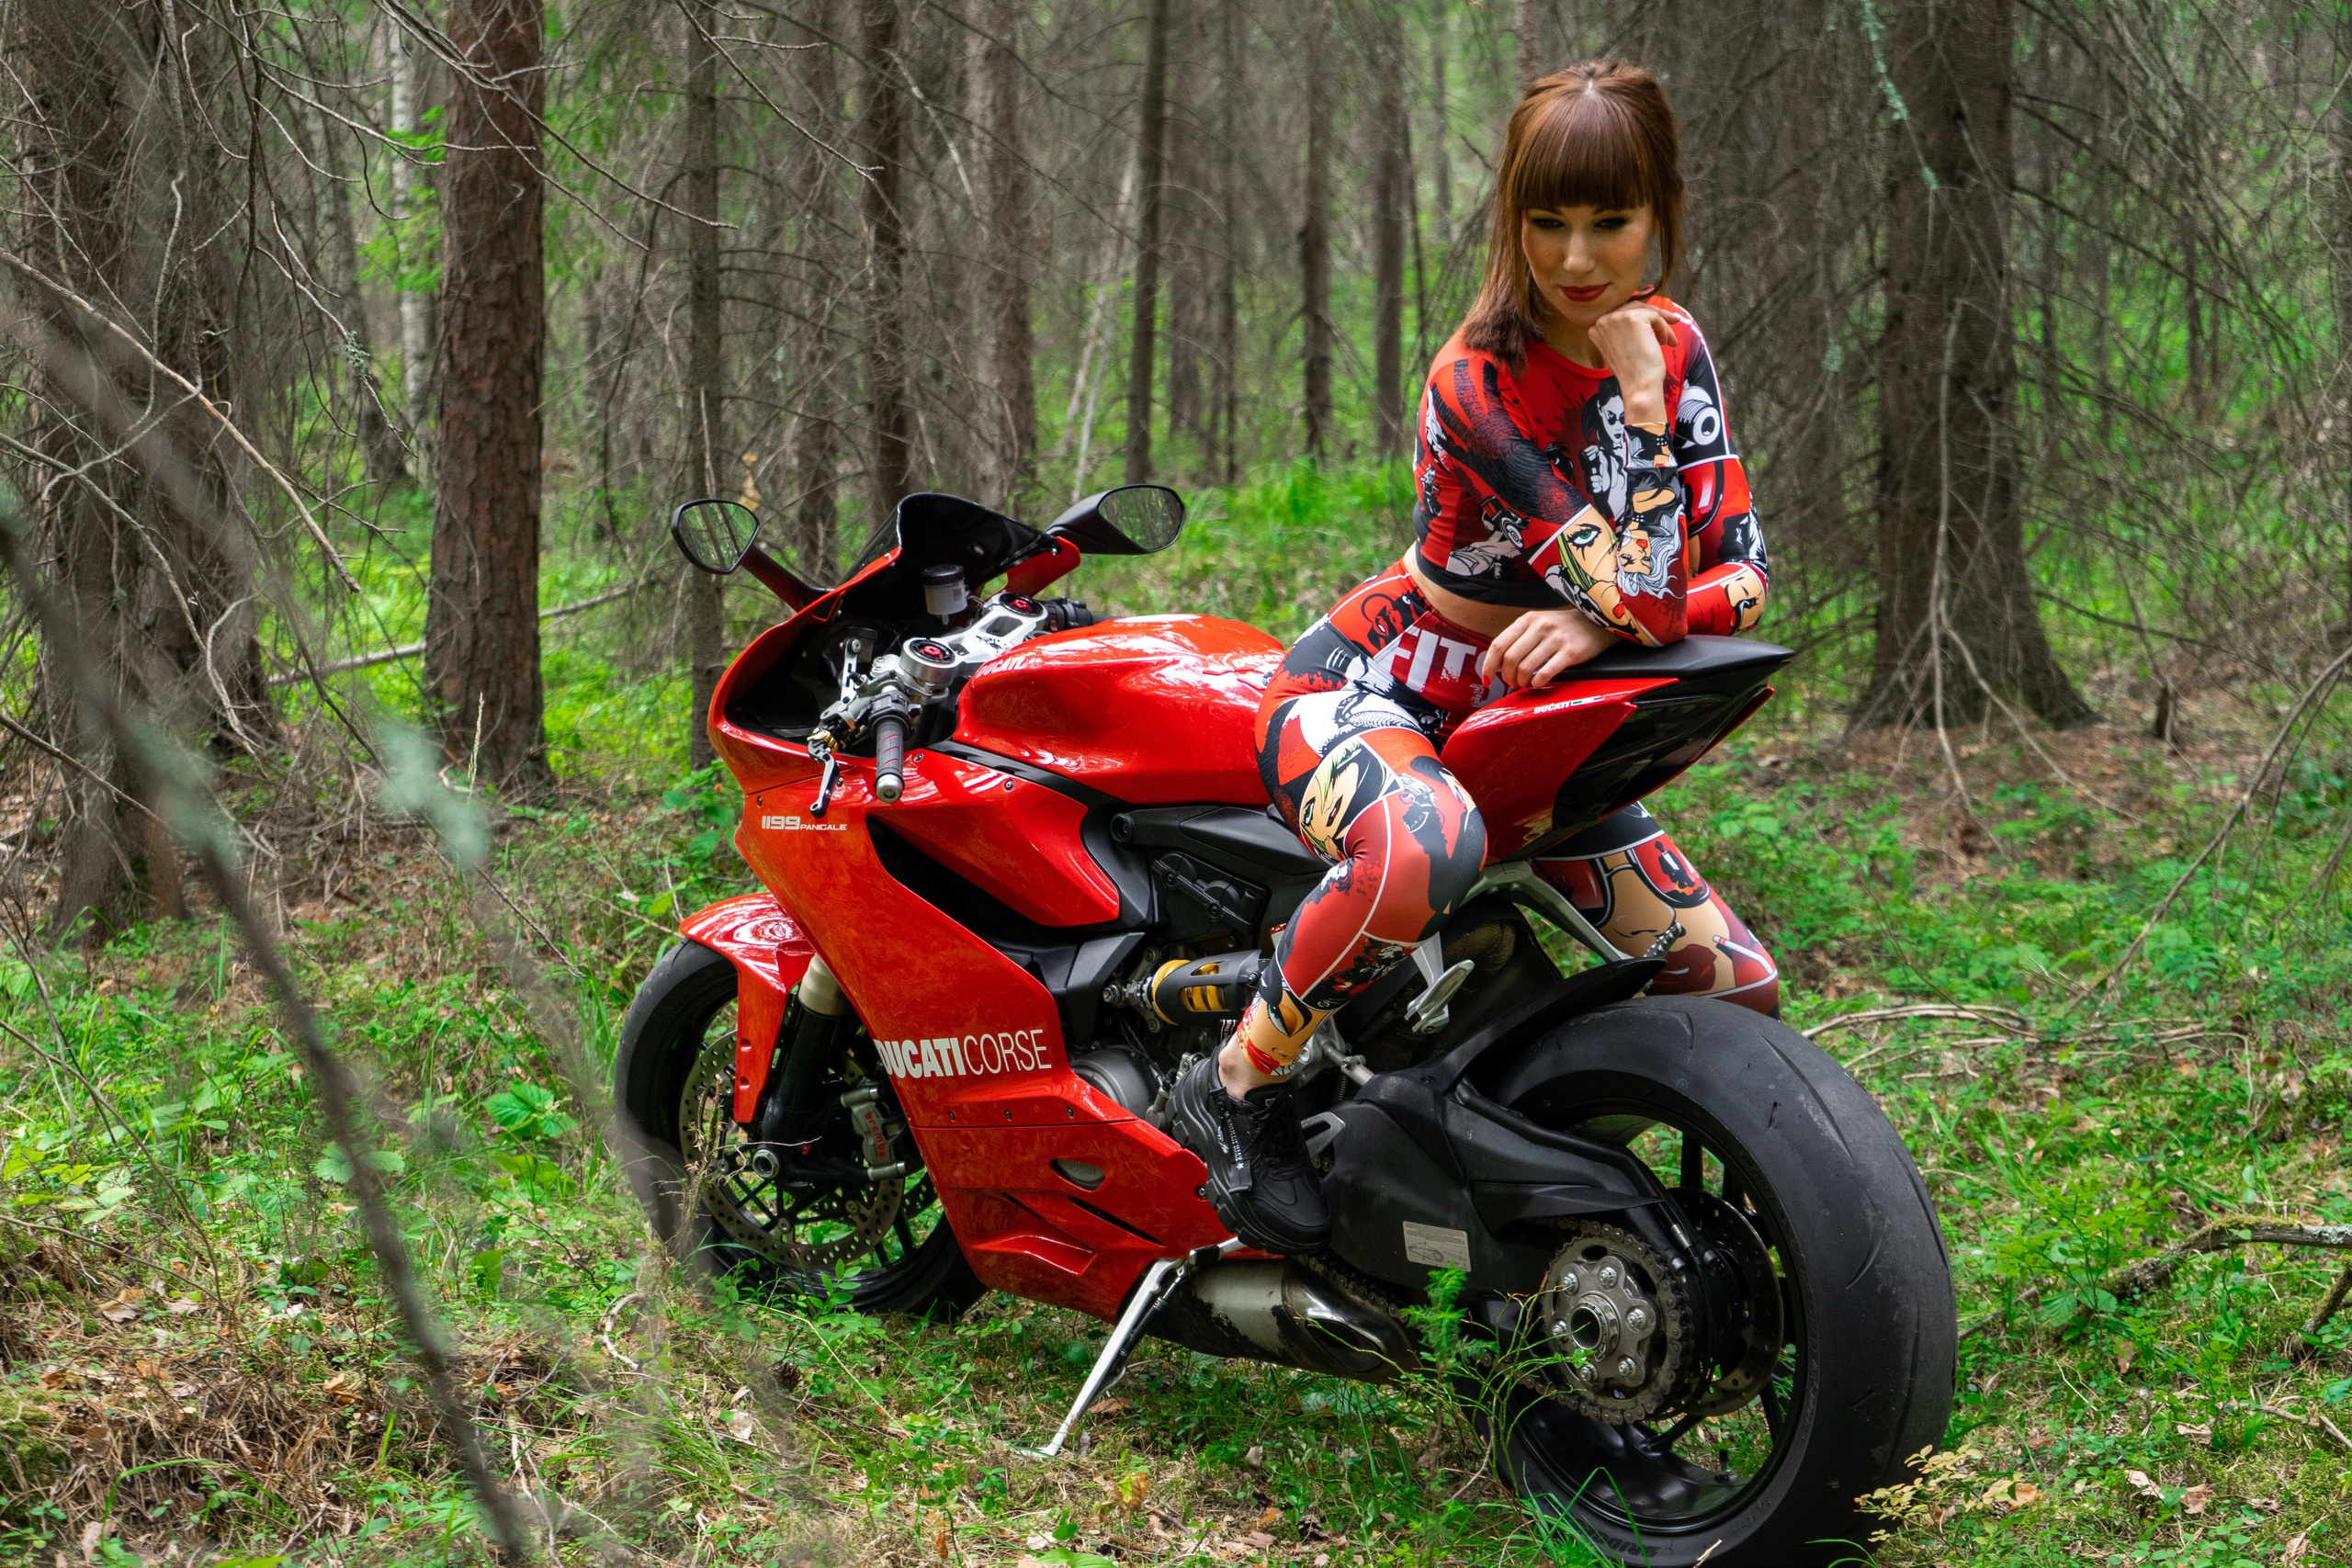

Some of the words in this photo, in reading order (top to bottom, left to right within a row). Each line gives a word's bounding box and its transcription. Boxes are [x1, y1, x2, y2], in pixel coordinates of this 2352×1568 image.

[1533, 701, 1571, 715] DUCATI
[762, 816, 800, 830] 1199
[874, 1039, 967, 1078] DUCATI
[964, 1029, 1052, 1076] CORSE
[865, 1111, 887, 1158] brembo
